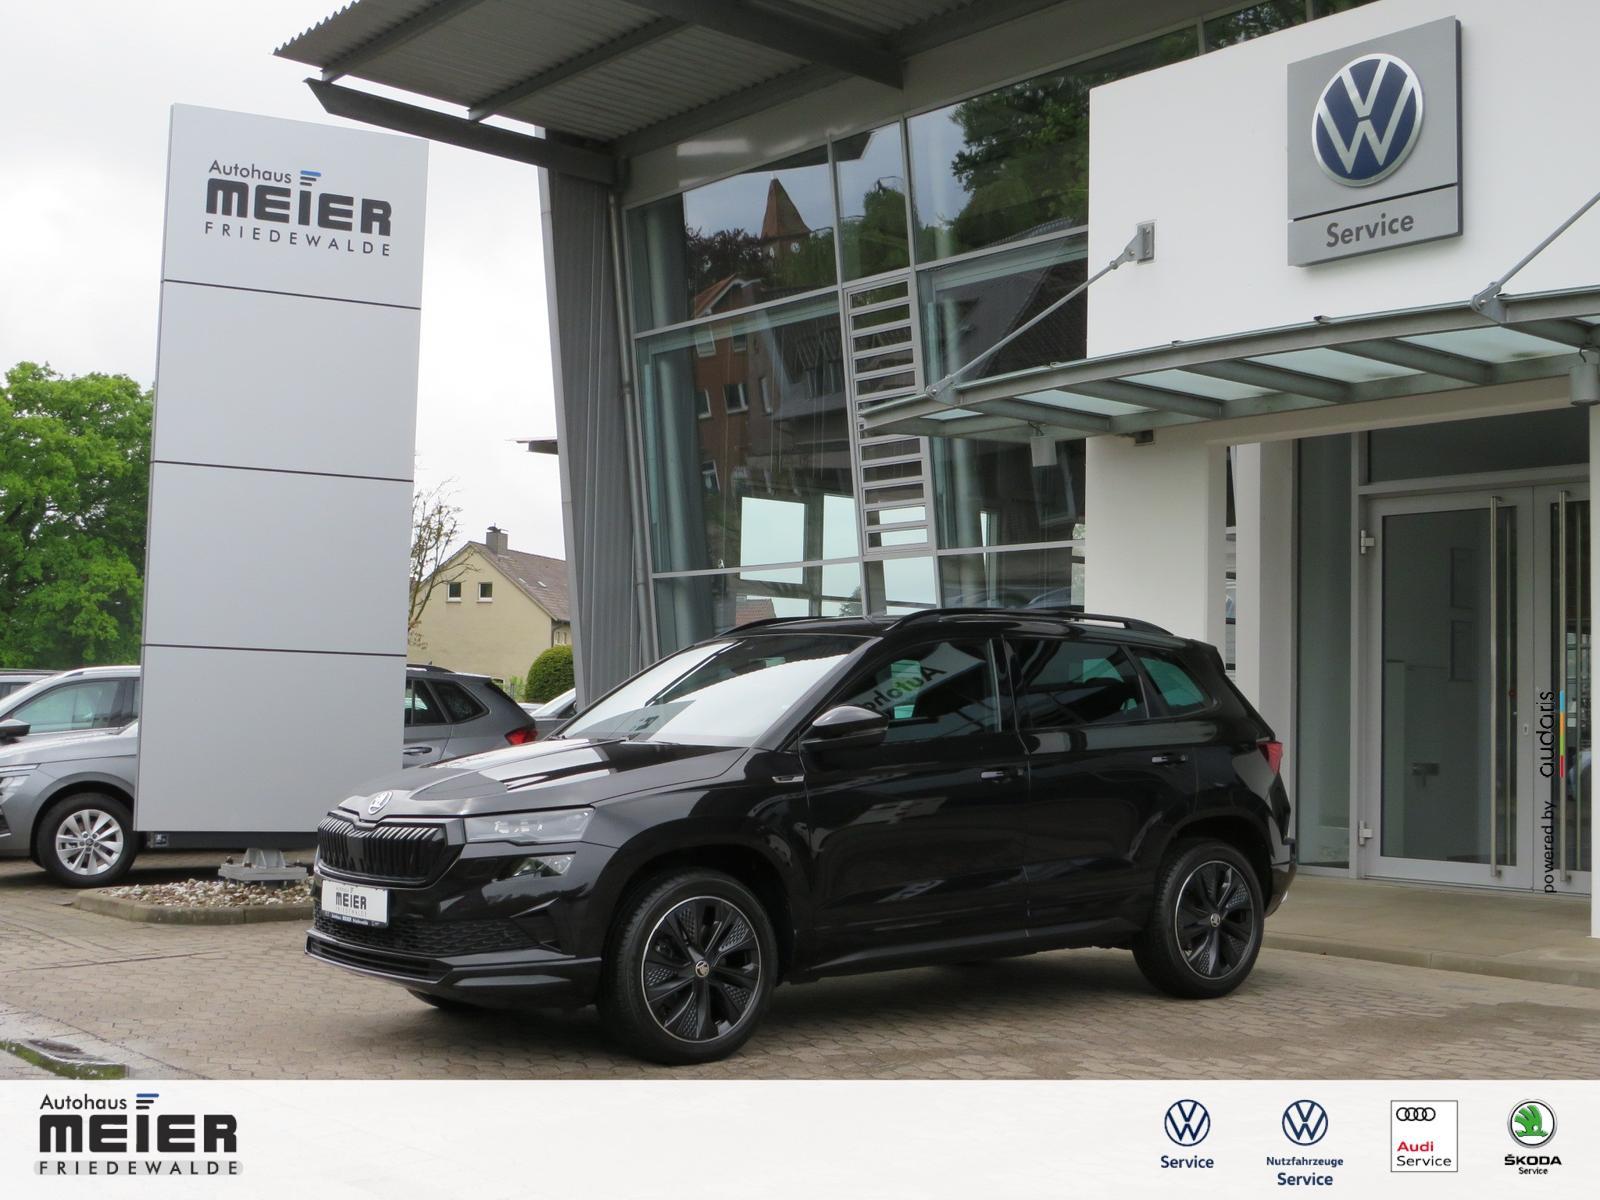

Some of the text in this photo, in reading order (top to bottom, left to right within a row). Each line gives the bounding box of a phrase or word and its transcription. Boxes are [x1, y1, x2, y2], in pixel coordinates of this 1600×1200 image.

[208, 159, 292, 184] Autohaus
[205, 177, 392, 237] MEIER
[204, 221, 391, 257] FRIEDEWALDE
[1325, 212, 1415, 248] Service
[335, 892, 367, 910] MEIER
